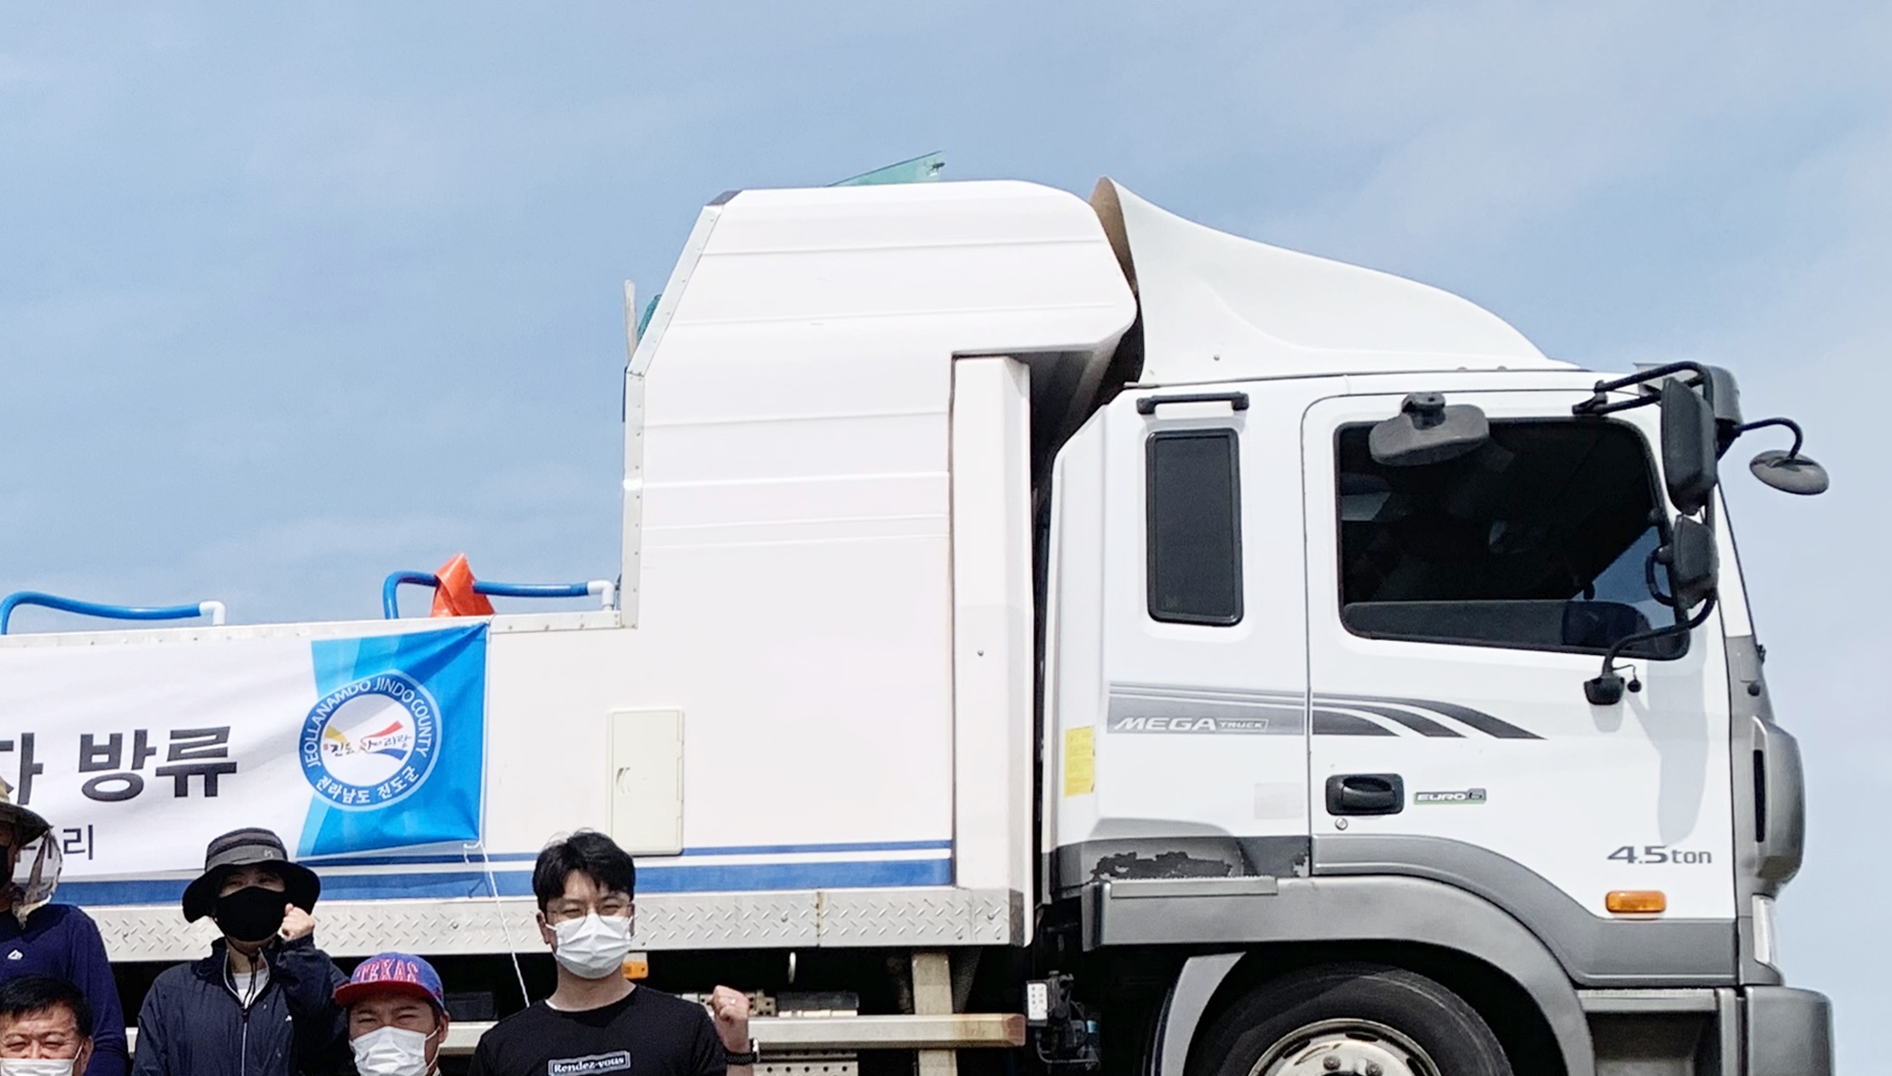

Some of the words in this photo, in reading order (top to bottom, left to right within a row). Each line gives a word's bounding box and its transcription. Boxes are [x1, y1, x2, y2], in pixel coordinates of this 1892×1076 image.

[304, 680, 371, 768] JEOLLANAMDO
[373, 677, 415, 703] JINDO
[411, 699, 433, 758] COUNTY
[1113, 717, 1216, 731] MEGA
[1220, 721, 1263, 729] TRUCK
[78, 726, 237, 802] 방류
[316, 775, 370, 804] 전라남도
[377, 766, 419, 799] 진도군
[356, 959, 418, 983] TEXAS
[554, 1057, 625, 1073] Rendez-vous
